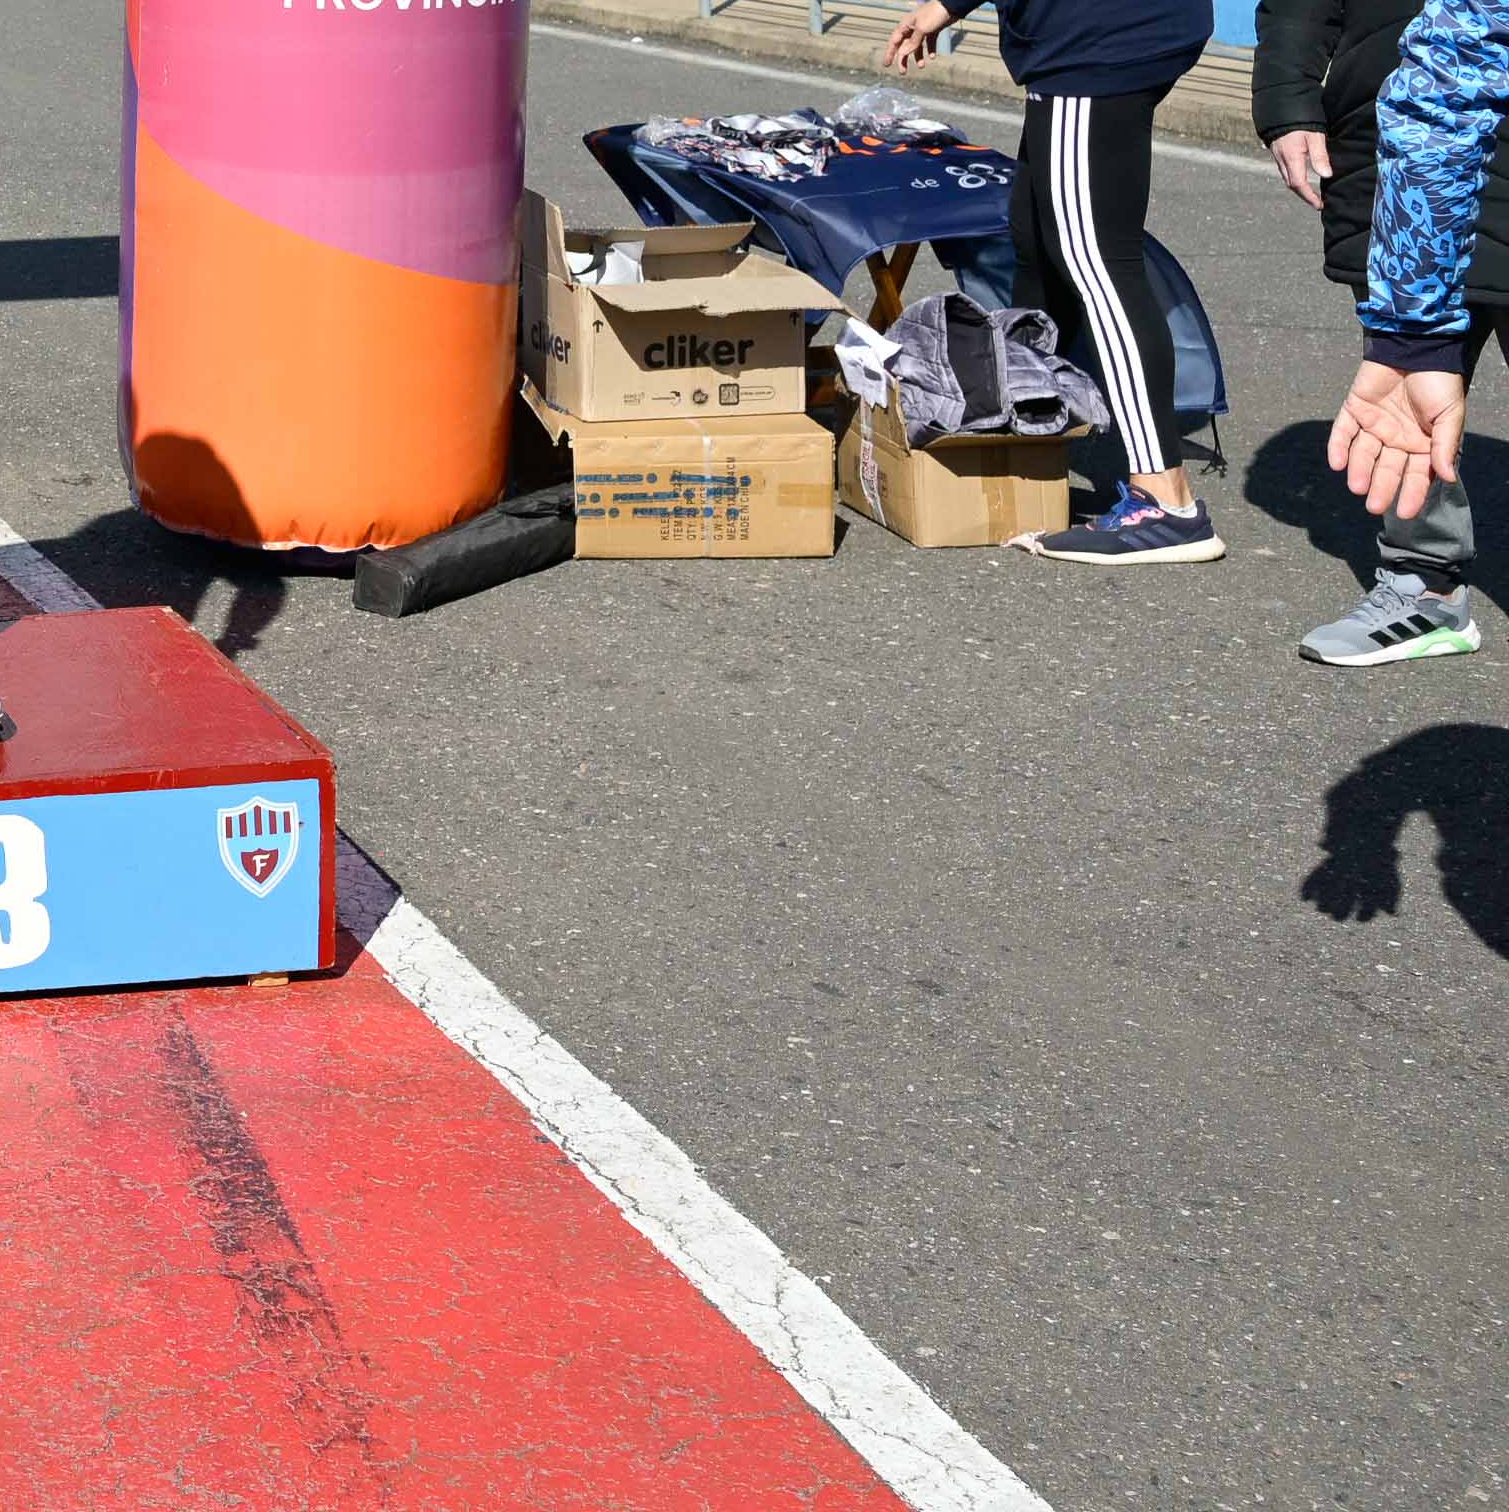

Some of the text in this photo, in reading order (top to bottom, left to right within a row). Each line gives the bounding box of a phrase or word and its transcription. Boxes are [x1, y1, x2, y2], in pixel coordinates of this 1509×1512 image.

[643, 335, 756, 370] cliker
[740, 515, 750, 541] MADE
[252, 853, 270, 877] F
